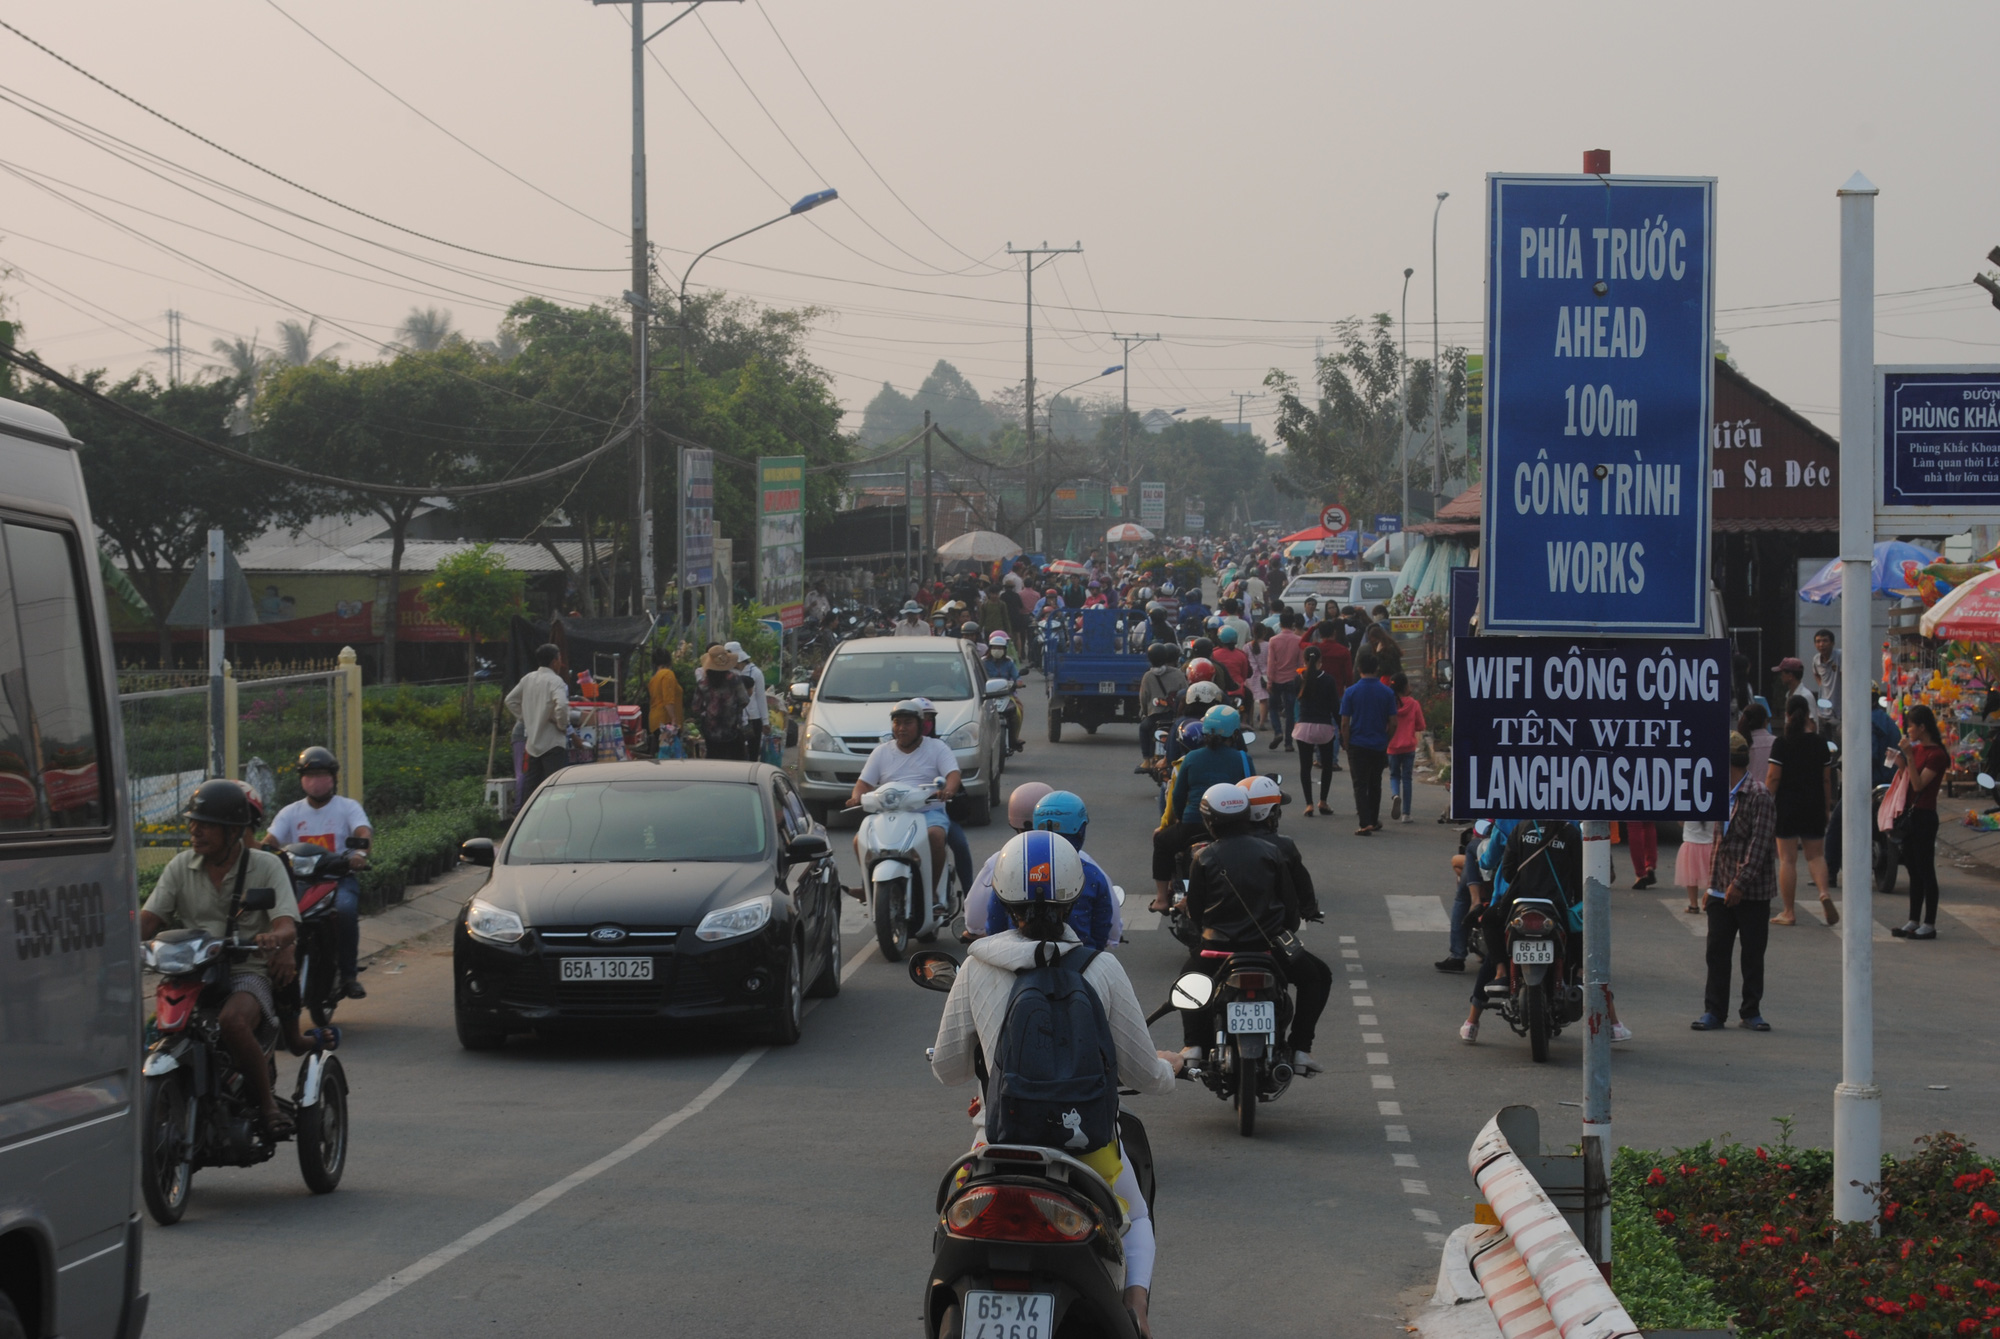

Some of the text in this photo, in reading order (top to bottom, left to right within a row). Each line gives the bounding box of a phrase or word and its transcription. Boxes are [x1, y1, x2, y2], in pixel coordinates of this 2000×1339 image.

[1521, 214, 1687, 281] PHÍA TRƯỚC
[1555, 306, 1646, 358] AHEAD
[1565, 384, 1637, 437] 100m
[1902, 400, 2000, 428] PHÙNG KHẮ
[1910, 442, 1940, 455] Phùng
[1744, 459, 1773, 486] Sa
[1786, 460, 1831, 486] Đéc
[1913, 457, 1935, 468] Làm
[1937, 460, 1962, 471] quan
[1925, 471, 1943, 483] nhà
[1515, 449, 1681, 516] CÔNG TRÌNH
[1547, 541, 1644, 595] WORKS
[1466, 646, 1719, 710] WIFI CÔNG CỘNG
[1493, 710, 1692, 748] TÊN WIFI:
[1470, 756, 1713, 812] LANGHOASADEC
[597, 929, 618, 939] Ford
[1519, 942, 1547, 952] 66-LA
[563, 960, 650, 979] 65A-130.25
[1235, 1004, 1266, 1017] 64-B1
[1230, 1018, 1272, 1031] 829.00
[978, 1295, 1039, 1322] 65-X4
